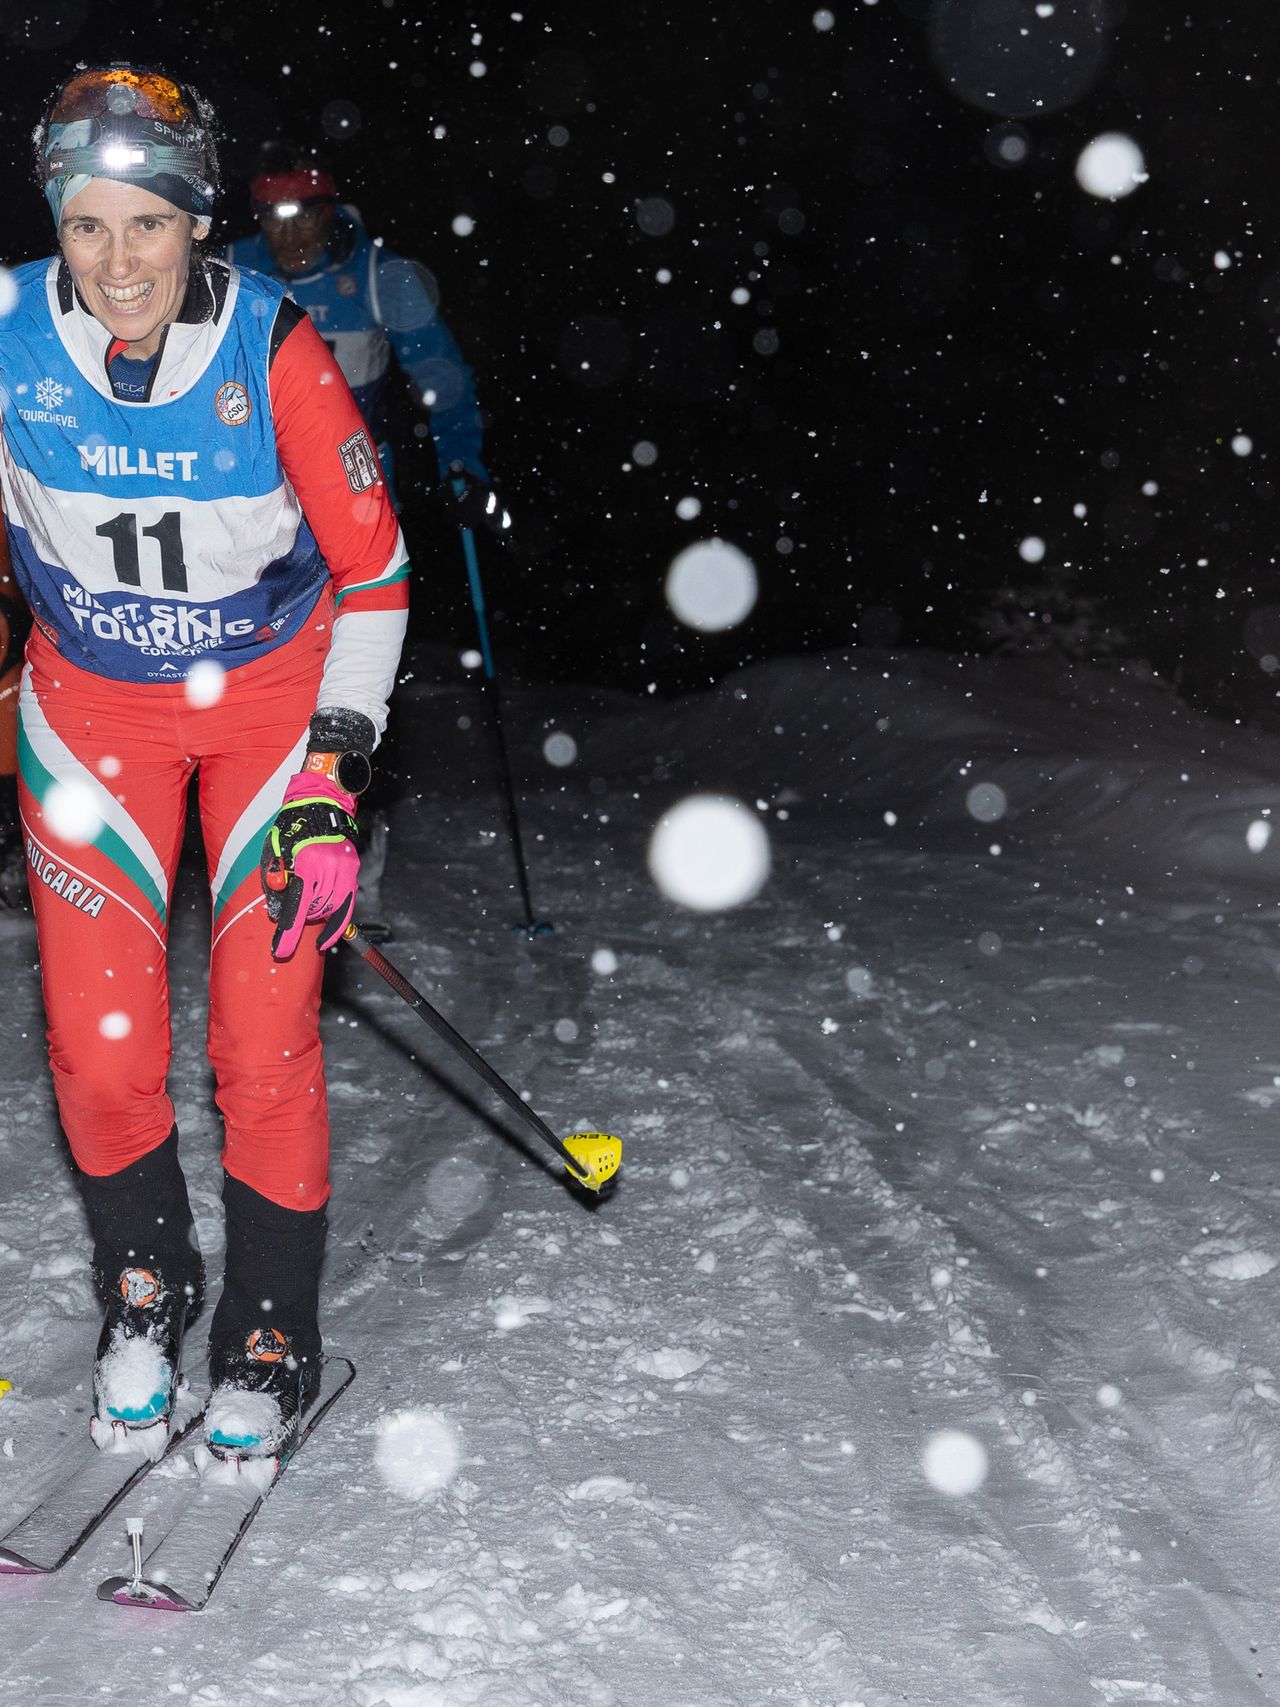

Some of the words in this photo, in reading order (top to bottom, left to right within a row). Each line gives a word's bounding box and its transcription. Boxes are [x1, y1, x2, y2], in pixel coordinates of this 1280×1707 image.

[113, 382, 147, 393] ACCA
[227, 403, 244, 419] CSO
[77, 445, 198, 482] MILLET
[96, 511, 188, 593] 11
